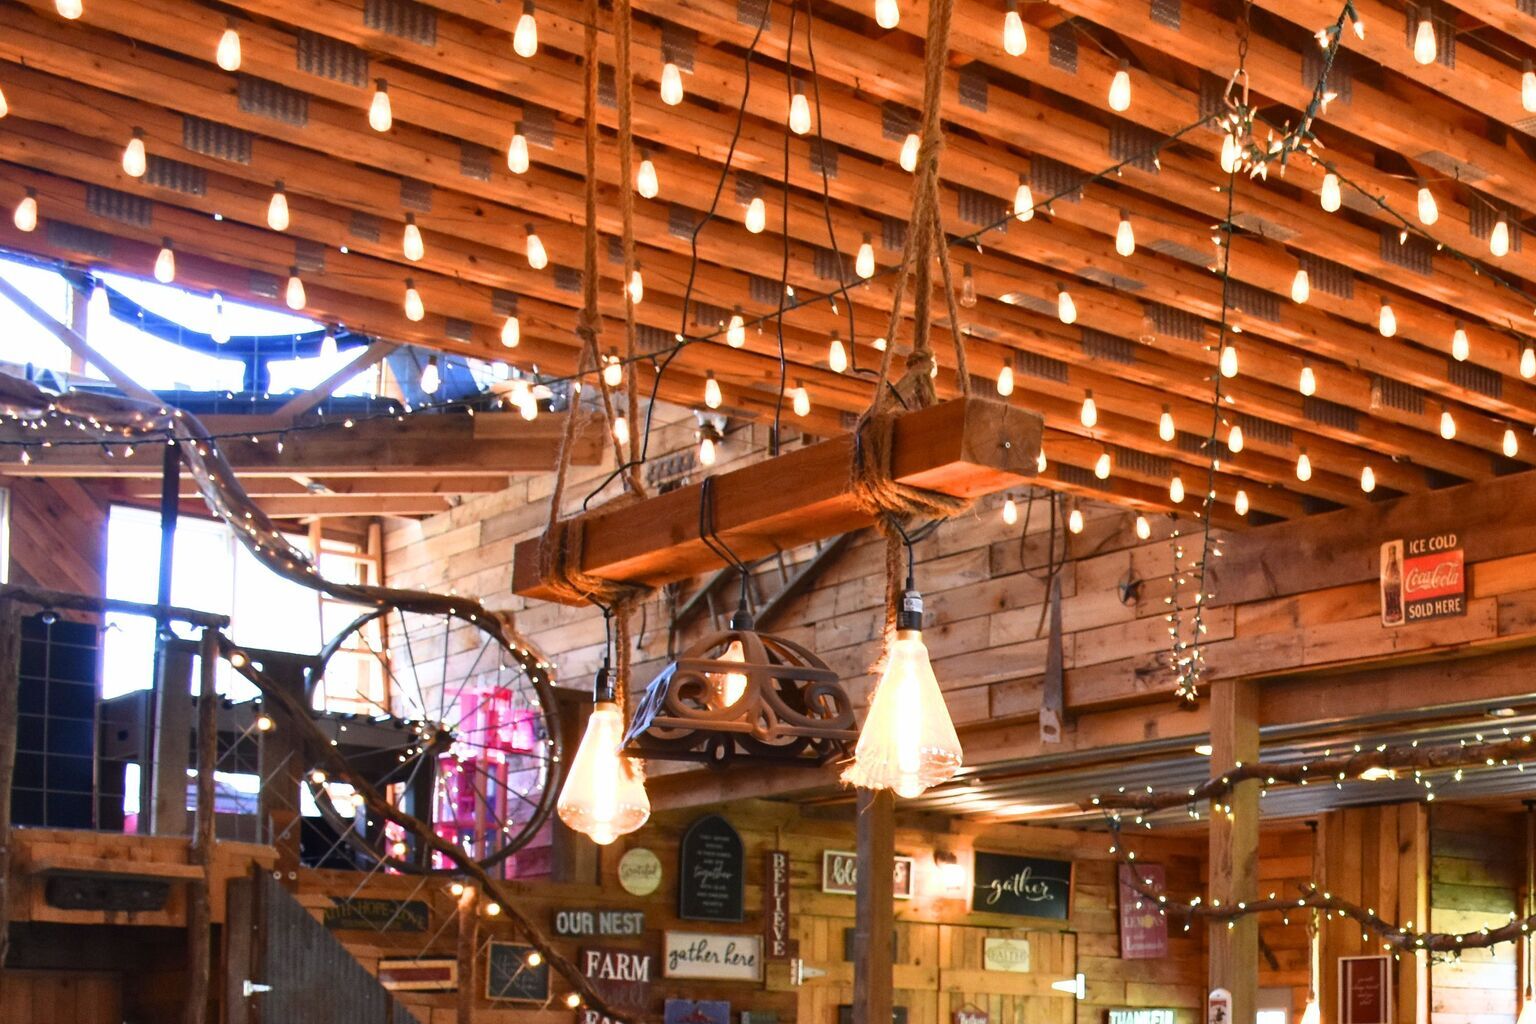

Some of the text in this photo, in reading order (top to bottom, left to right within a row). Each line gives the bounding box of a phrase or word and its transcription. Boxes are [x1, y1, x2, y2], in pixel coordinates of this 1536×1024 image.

[1409, 534, 1457, 554] ICE COLD
[1409, 598, 1462, 619] SOLD HERE
[977, 865, 1067, 905] gather
[773, 852, 786, 957] BELIEVE
[556, 911, 644, 935] OUR NEST
[585, 950, 650, 983] FARM
[668, 938, 755, 971] gather here
